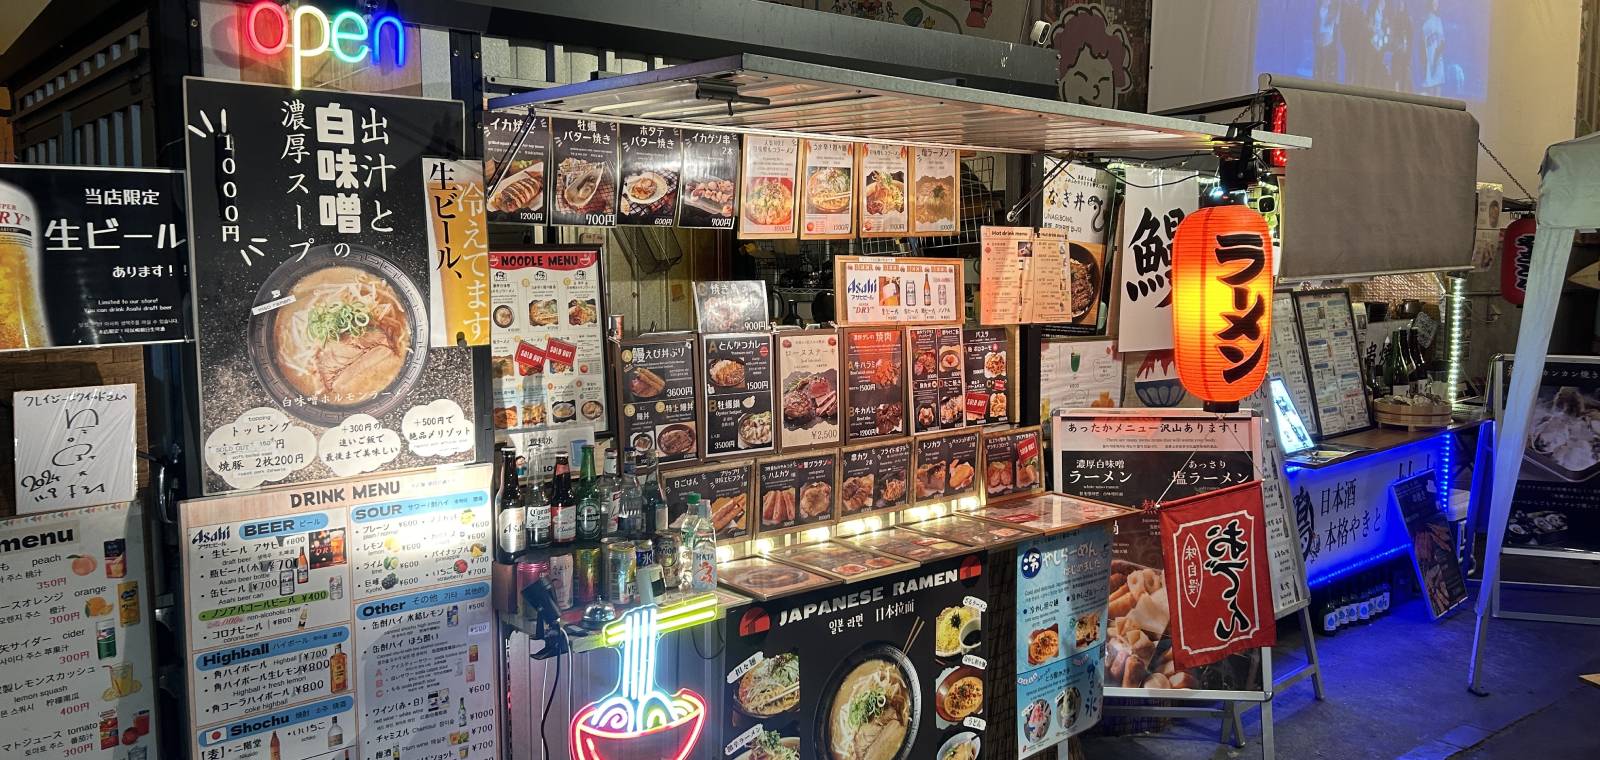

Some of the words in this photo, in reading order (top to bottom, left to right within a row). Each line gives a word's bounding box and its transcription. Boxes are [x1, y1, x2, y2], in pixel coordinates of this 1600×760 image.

[246, 0, 406, 90] open
[576, 119, 598, 132] 牡蠣
[640, 126, 664, 137] ホタテ
[563, 130, 611, 145] バター焼き
[630, 136, 675, 149] バター焼き
[691, 133, 731, 146] イカゲソ串
[360, 106, 397, 235] 出汁と
[220, 134, 241, 242] 1000円
[280, 99, 315, 263] 濃厚スープ
[315, 103, 363, 259] 白味噌の
[85, 188, 160, 206] 当店限定
[520, 212, 543, 221] 1200円
[585, 213, 616, 226] 700円
[654, 217, 673, 226] 600円
[711, 217, 732, 227] 700円
[45, 217, 186, 251] 生ビール
[455, 180, 490, 340] 冷えてます
[501, 255, 543, 267] NOODLE
[548, 255, 579, 266] MENU
[854, 263, 873, 271] BEER
[882, 263, 900, 272] BEER
[906, 264, 923, 272] BEER
[930, 265, 948, 273] BEER
[847, 278, 877, 294] Asahi
[1215, 233, 1265, 385] ラーメン
[744, 321, 767, 331] 900円
[549, 345, 562, 355] SOLD
[562, 349, 573, 359] OUT
[718, 341, 769, 351] とんかつカレー
[520, 349, 532, 360] SOLD
[532, 354, 543, 363] OUT
[667, 386, 693, 398] 3600円
[746, 380, 769, 390] 1500円
[859, 383, 876, 392] 1500円
[855, 406, 877, 415] 牛カルビ
[232, 422, 290, 437] トッピング
[811, 430, 838, 440] ¥2,500
[1067, 422, 1239, 434] あったかメニュー沢山あります！
[714, 440, 735, 450] 3500円
[923, 440, 941, 449] トンカツ
[325, 446, 398, 462] 最後まで美味しい
[218, 460, 245, 472] 焼豚
[255, 453, 304, 468] 2枚200円
[1076, 459, 1125, 469] 濃厚白味噌
[1188, 459, 1226, 469] あっさり
[20, 469, 61, 492] 2024
[768, 470, 790, 479] ハムカツ
[1069, 471, 1132, 485] ラーメン
[1172, 471, 1249, 486] 塩ラーメン
[290, 487, 346, 508] DRINK
[353, 480, 400, 500] MENU
[1321, 478, 1357, 517] 日本酒
[355, 504, 402, 520] SOUR
[192, 525, 231, 544] Asahi
[244, 519, 295, 537] BEER
[299, 519, 321, 528] ビール
[363, 523, 390, 534] プレーン
[0, 528, 74, 552] menu
[363, 541, 384, 551] レモン
[212, 544, 248, 560] 生ビール
[431, 546, 469, 558] パイナップル
[32, 553, 62, 568] peach
[237, 556, 252, 565] beer
[363, 561, 383, 570] ライム
[400, 560, 419, 569] ¥600
[432, 567, 454, 576] いちご
[36, 577, 68, 590] 350円
[219, 577, 237, 586] Asahi
[238, 575, 252, 584] beer
[400, 577, 419, 586] ¥600
[74, 584, 107, 598] orange
[210, 583, 246, 599] 缶ビール
[301, 590, 328, 602] ¥400
[779, 586, 884, 627] JAPANESE
[892, 568, 959, 596] RAMEN
[212, 596, 296, 617] ノンアルコールビール
[218, 597, 236, 606] Asahi
[237, 595, 252, 604] beer
[362, 600, 406, 617] Other
[412, 594, 438, 605] その他
[26, 610, 41, 620] 주스
[49, 611, 81, 625] 300円
[287, 606, 301, 616] beer
[372, 615, 403, 630] 缶酎ハイ
[828, 617, 844, 635] 일본
[847, 613, 864, 628] 라면
[62, 628, 85, 640] cider
[212, 622, 263, 640] コロナビール
[303, 648, 328, 660] ¥700
[372, 640, 403, 654] 缶酎ハイ
[26, 651, 42, 660] 주스
[59, 650, 90, 665] 300円
[203, 643, 270, 667] Highball
[214, 662, 268, 679] 角ハイボール
[273, 655, 298, 665] Highball
[301, 659, 330, 672] ¥800
[214, 667, 301, 692] 角ハイボール生レモン
[233, 686, 261, 697] Highball
[268, 680, 285, 689] fresh
[286, 675, 307, 685] lemon
[14, 691, 38, 703] lemon
[40, 684, 68, 697] squash
[295, 680, 324, 694] ¥800
[469, 683, 491, 694] ¥600
[212, 688, 290, 714] 角コーラハイボール
[60, 701, 90, 716] 400円
[67, 722, 98, 735] tomato
[230, 715, 290, 737] Shochu
[292, 721, 326, 737] いいちこ
[375, 728, 410, 742] チャミスル
[469, 709, 494, 721] ¥1000
[471, 724, 493, 735] ¥700
[967, 717, 983, 728] うどん
[63, 743, 93, 758] 300円
[234, 738, 262, 753] 二階堂
